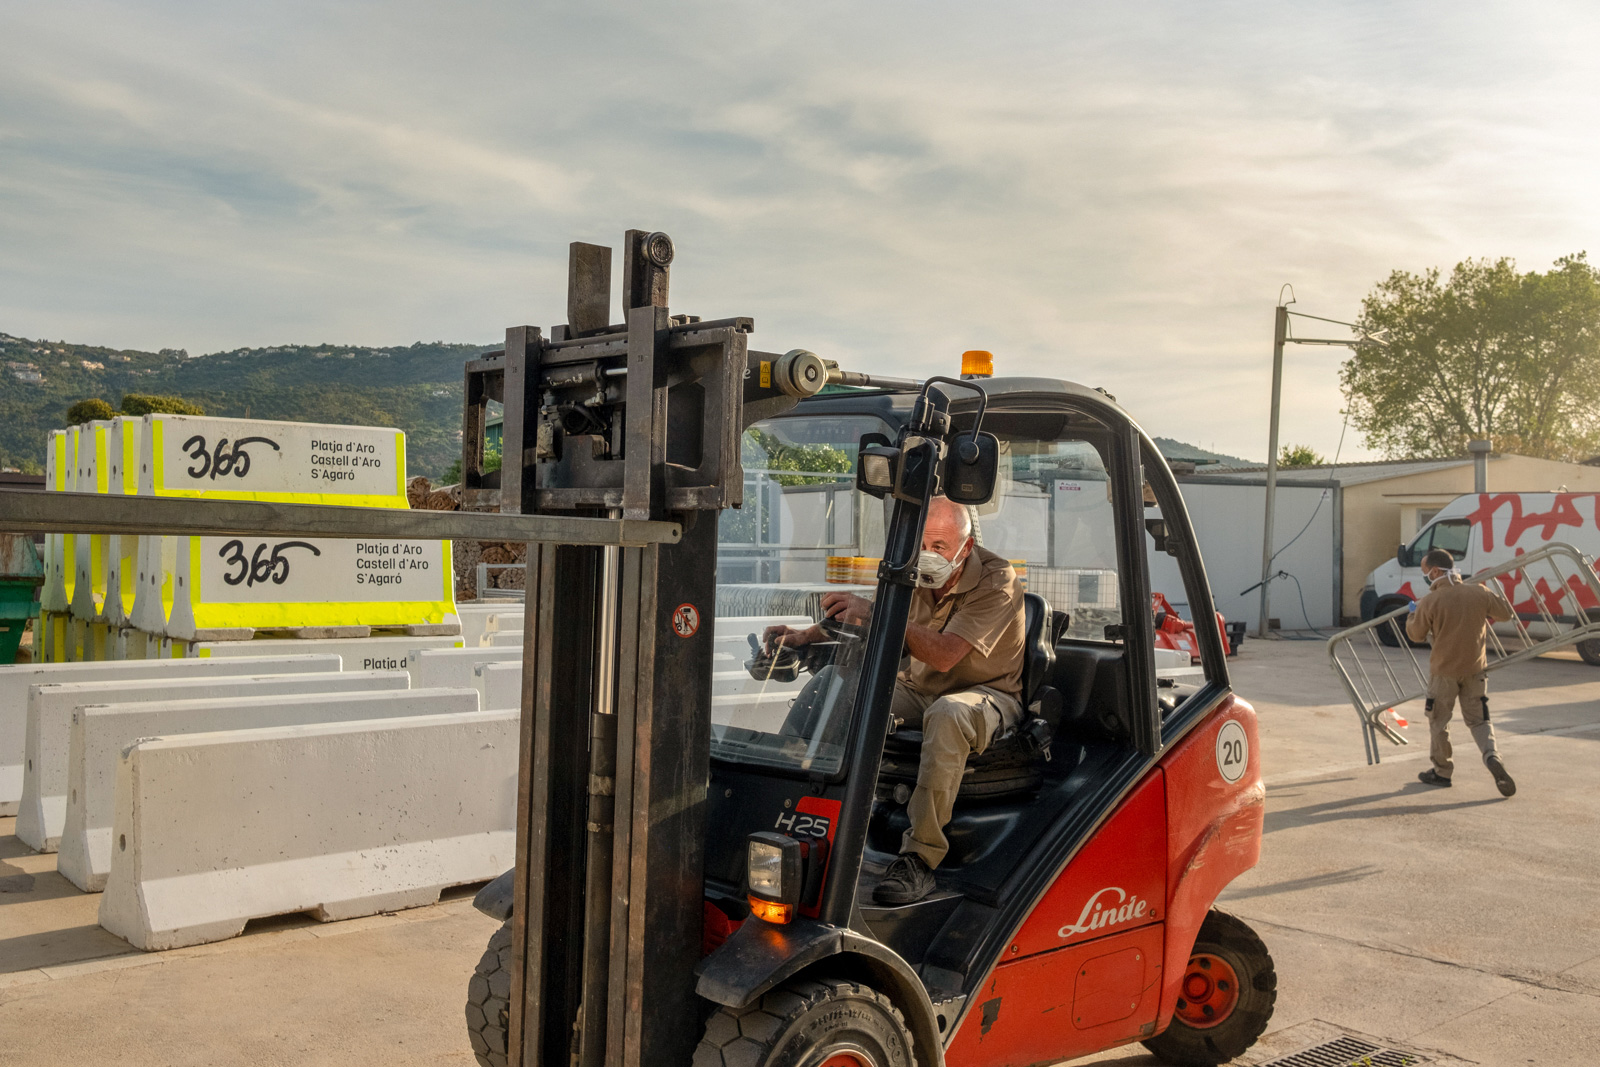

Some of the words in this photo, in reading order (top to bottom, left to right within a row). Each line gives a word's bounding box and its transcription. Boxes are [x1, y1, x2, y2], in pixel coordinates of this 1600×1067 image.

[311, 439, 343, 454] Platja
[345, 441, 375, 454] d'Aro
[181, 434, 281, 481] 365
[310, 454, 349, 466] Castell
[351, 455, 381, 468] d'Aro
[310, 468, 355, 482] S'Agaró
[356, 542, 389, 557] Platja
[392, 543, 423, 555] d'Aro
[218, 539, 322, 588] 365
[356, 558, 396, 570] Castell
[398, 558, 429, 570] d'Aro
[356, 572, 402, 587] S'Agaró
[363, 656, 397, 670] Platja
[400, 656, 407, 669] d
[1222, 739, 1243, 766] 20
[1057, 886, 1147, 938] Linde
